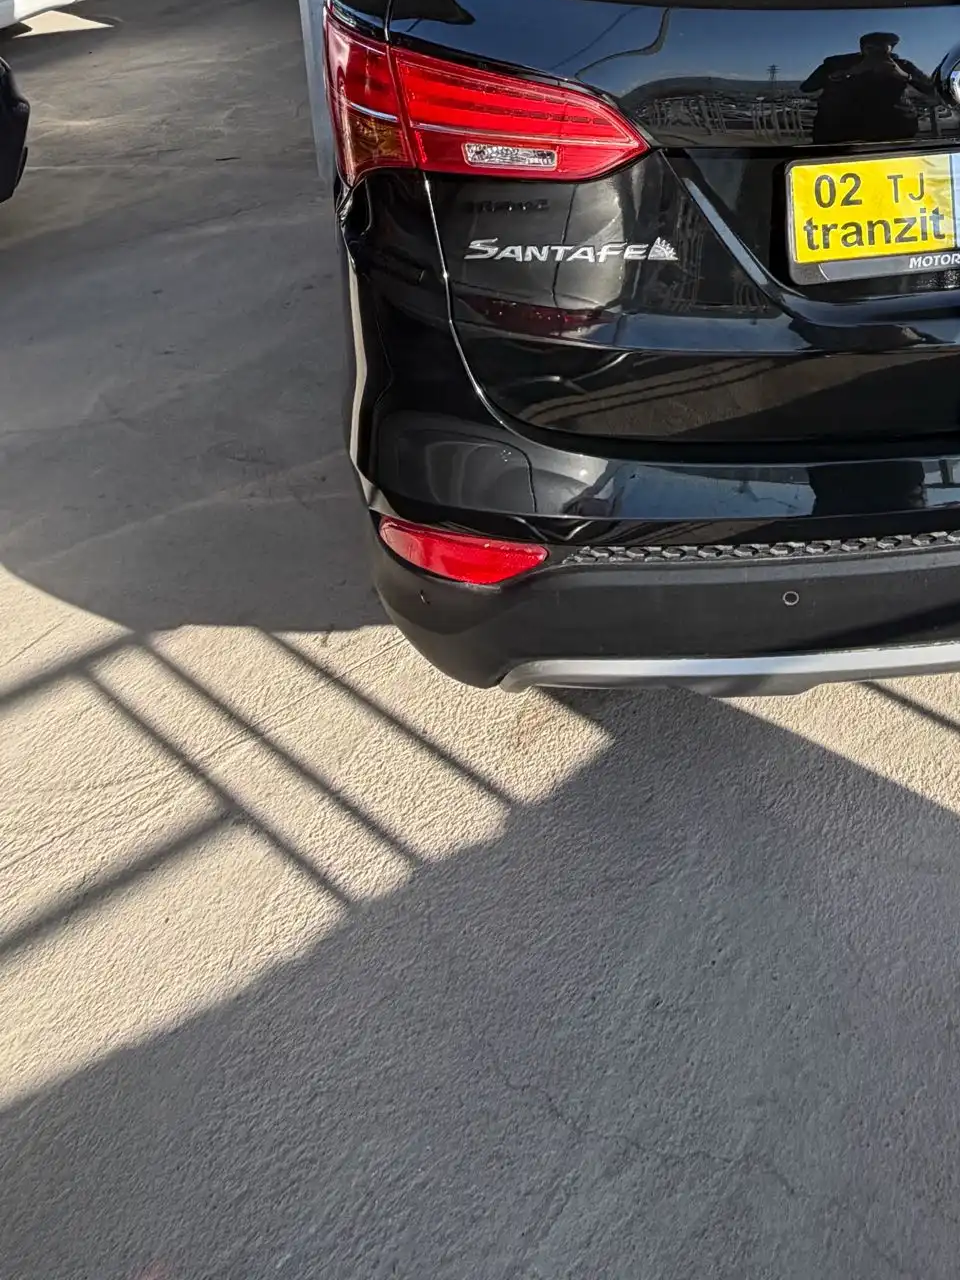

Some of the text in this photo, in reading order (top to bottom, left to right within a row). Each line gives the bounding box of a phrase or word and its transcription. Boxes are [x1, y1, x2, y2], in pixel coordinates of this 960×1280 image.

[813, 172, 926, 209] 02 TJ
[803, 207, 946, 251] tranzit
[909, 252, 960, 269] MOTOR
